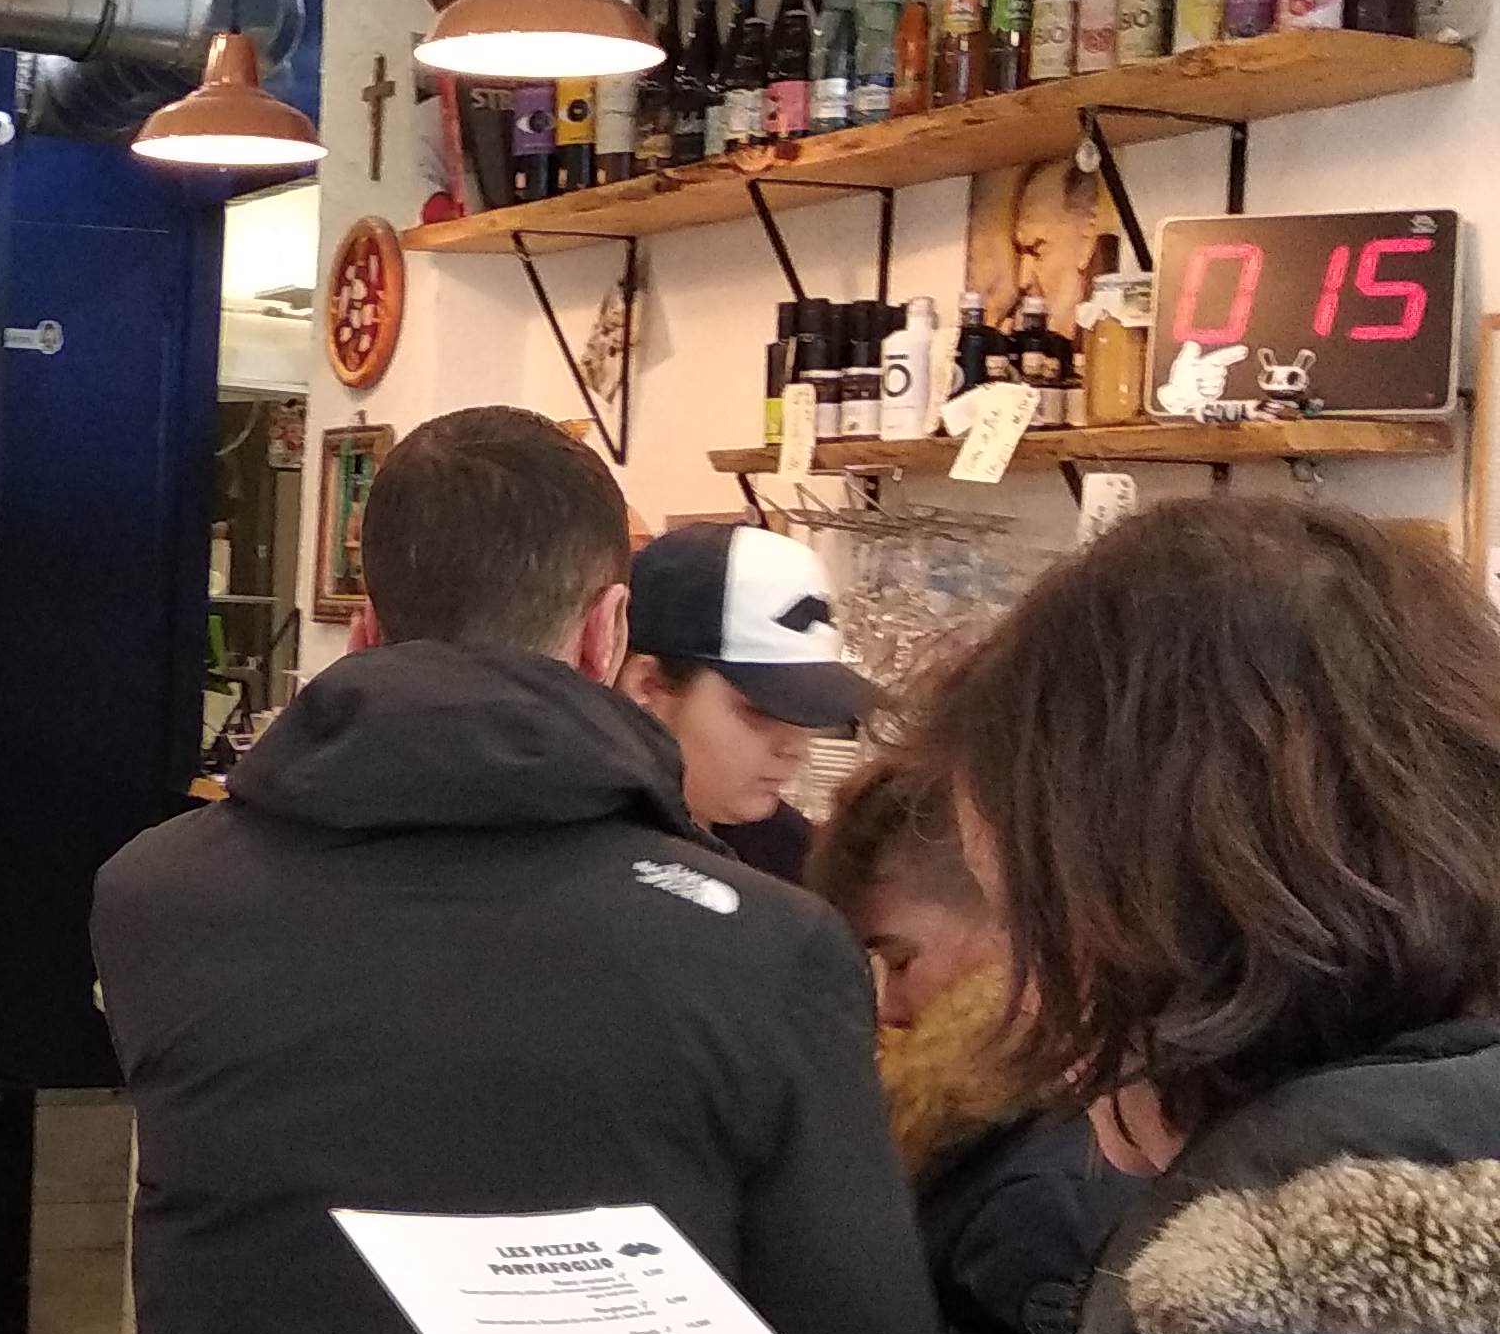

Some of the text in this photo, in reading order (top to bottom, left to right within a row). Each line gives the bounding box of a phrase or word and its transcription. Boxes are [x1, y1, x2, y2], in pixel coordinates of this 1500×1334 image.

[495, 1241, 604, 1259] LES PIZZAS
[487, 1257, 615, 1276] PORTAFOGLIO
